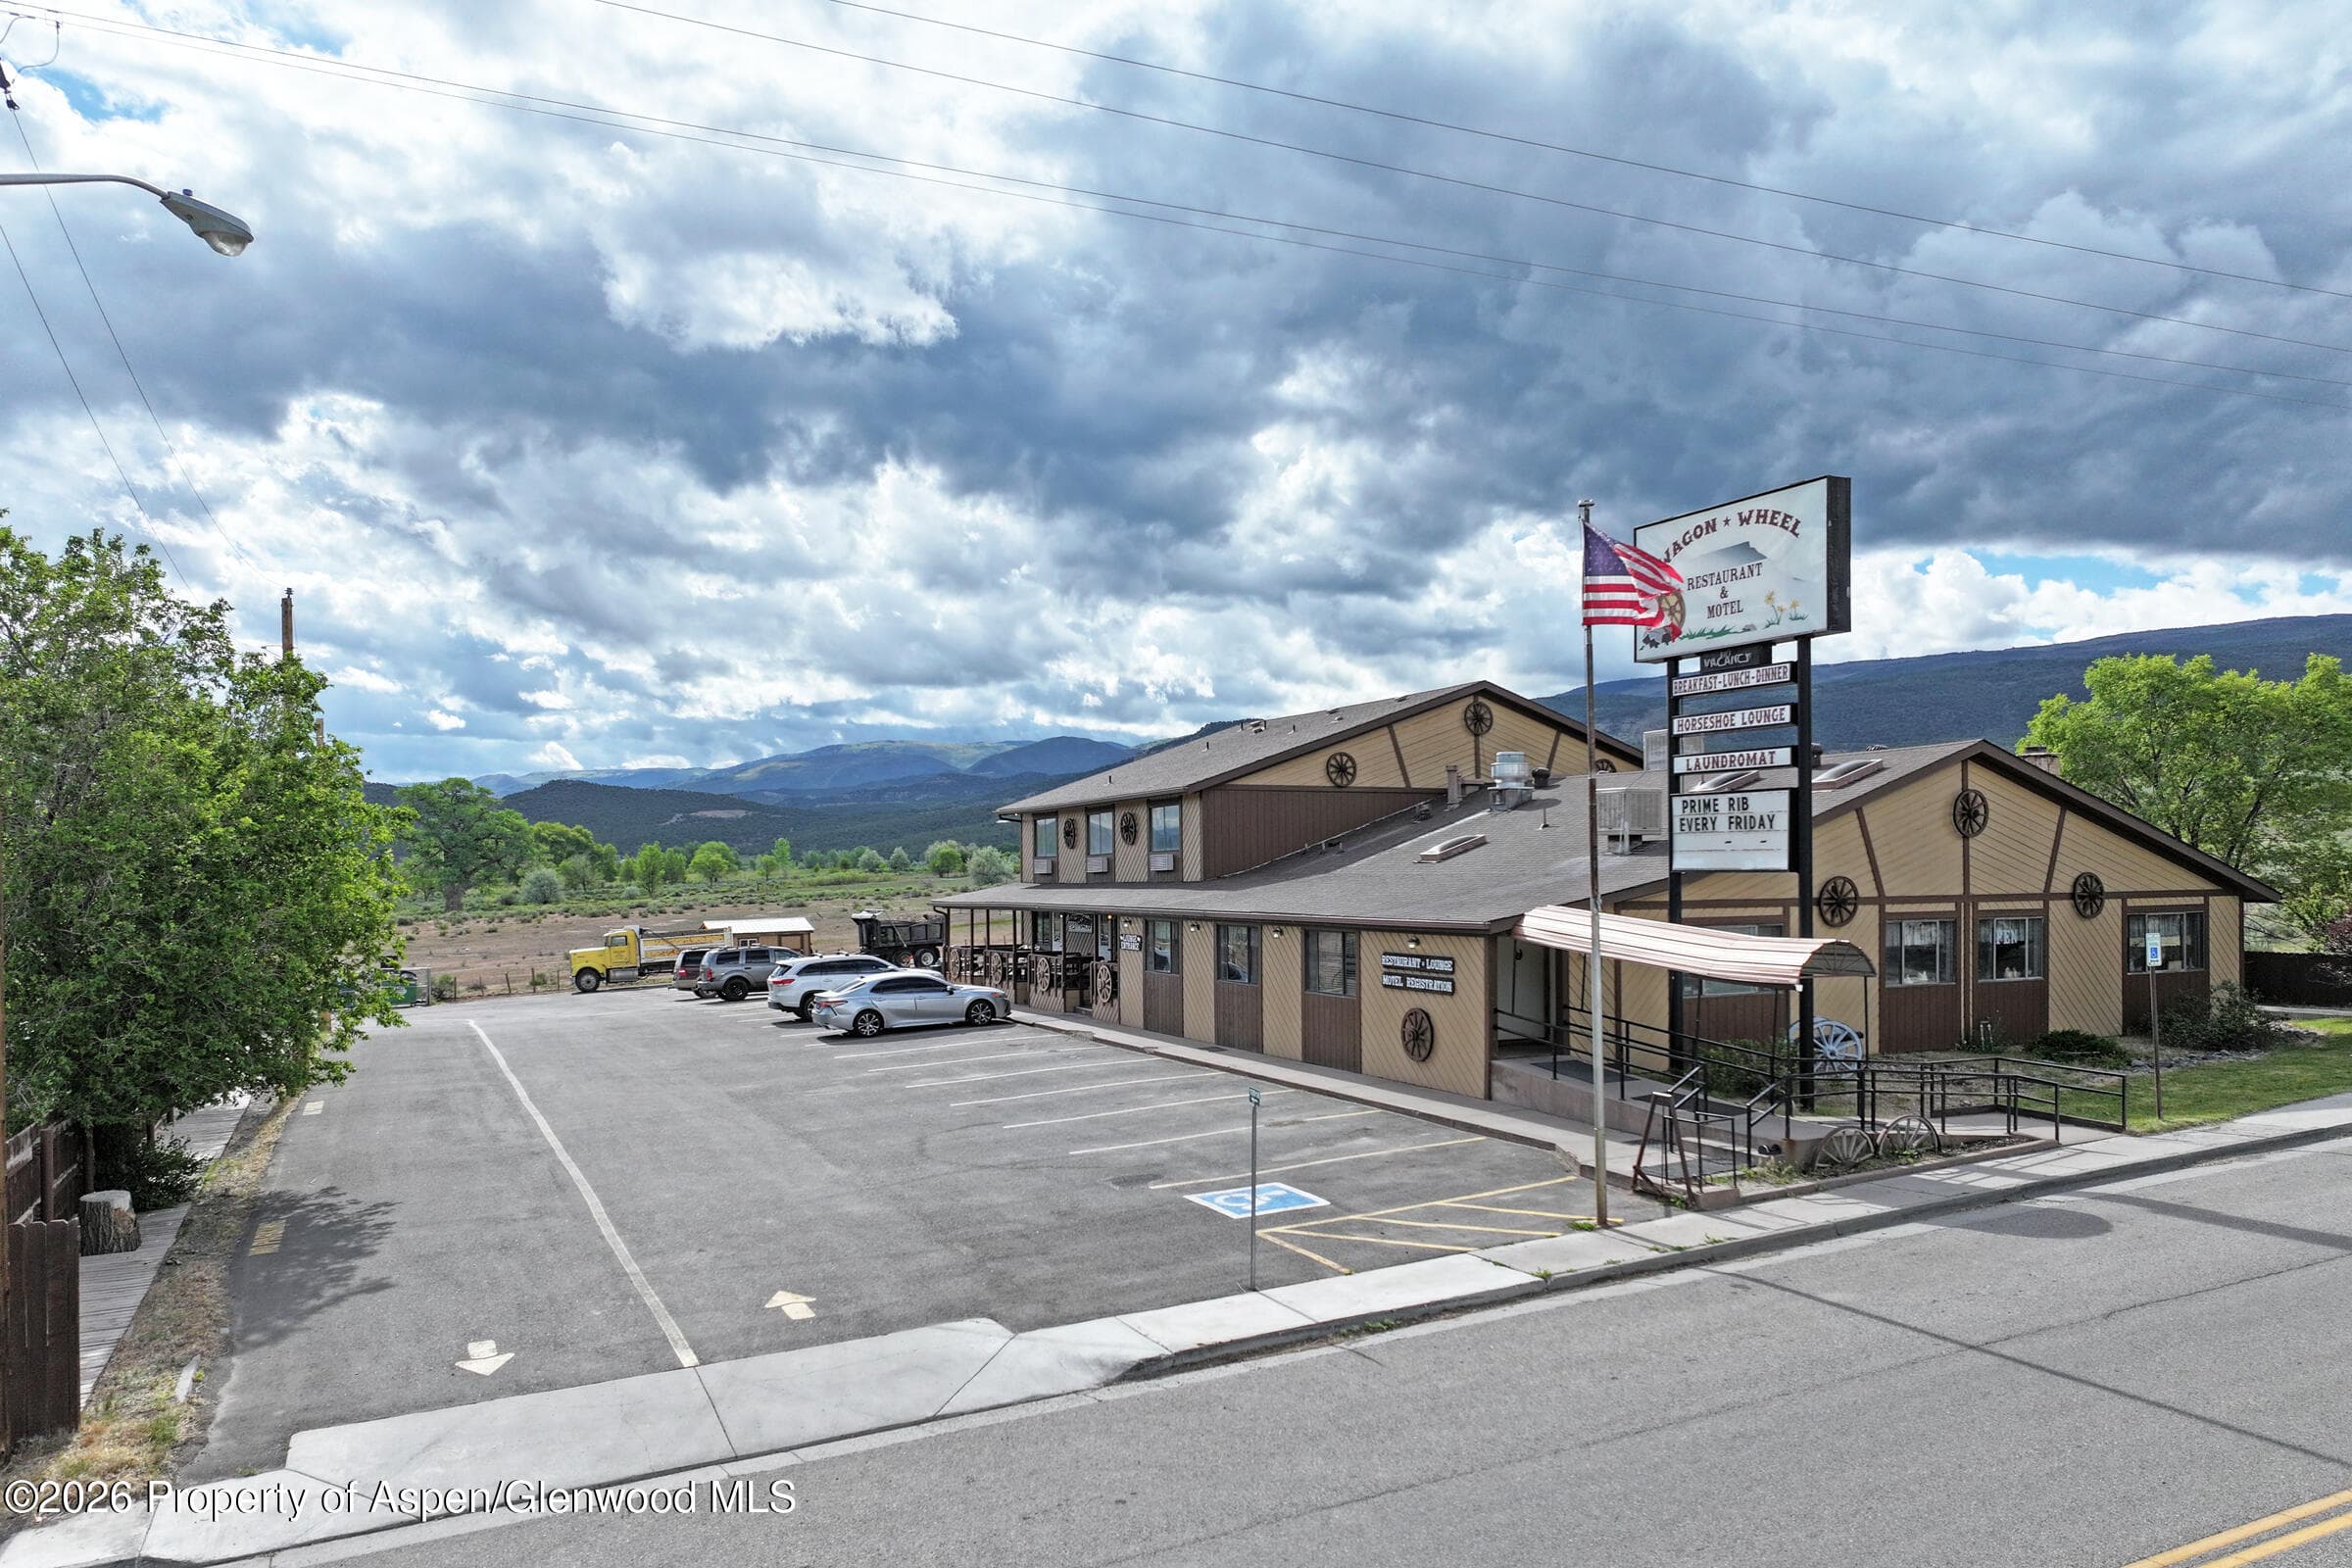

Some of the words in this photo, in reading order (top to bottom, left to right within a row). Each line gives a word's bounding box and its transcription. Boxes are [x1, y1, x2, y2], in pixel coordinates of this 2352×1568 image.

[1737, 508, 1801, 538] WHEEL
[1687, 562, 1763, 591] RESTAURANT
[1719, 586, 1729, 599] &
[1707, 600, 1743, 618] MOTEL
[1703, 652, 1752, 667] VACANCY
[1677, 713, 1736, 732] HORSESHOE
[1741, 708, 1786, 725] LOUNGE
[1686, 751, 1777, 772] LAUNDROMAT
[1682, 798, 1719, 814] PRIME
[1728, 796, 1749, 812] RIB
[1680, 815, 1717, 832] EVERY
[1728, 813, 1776, 831] FRIDAY
[1381, 956, 1421, 968] RESTAURANT
[1426, 959, 1453, 971] LOUNGE
[1383, 975, 1403, 986] MOTEL
[1406, 977, 1452, 992] REGISTRATION
